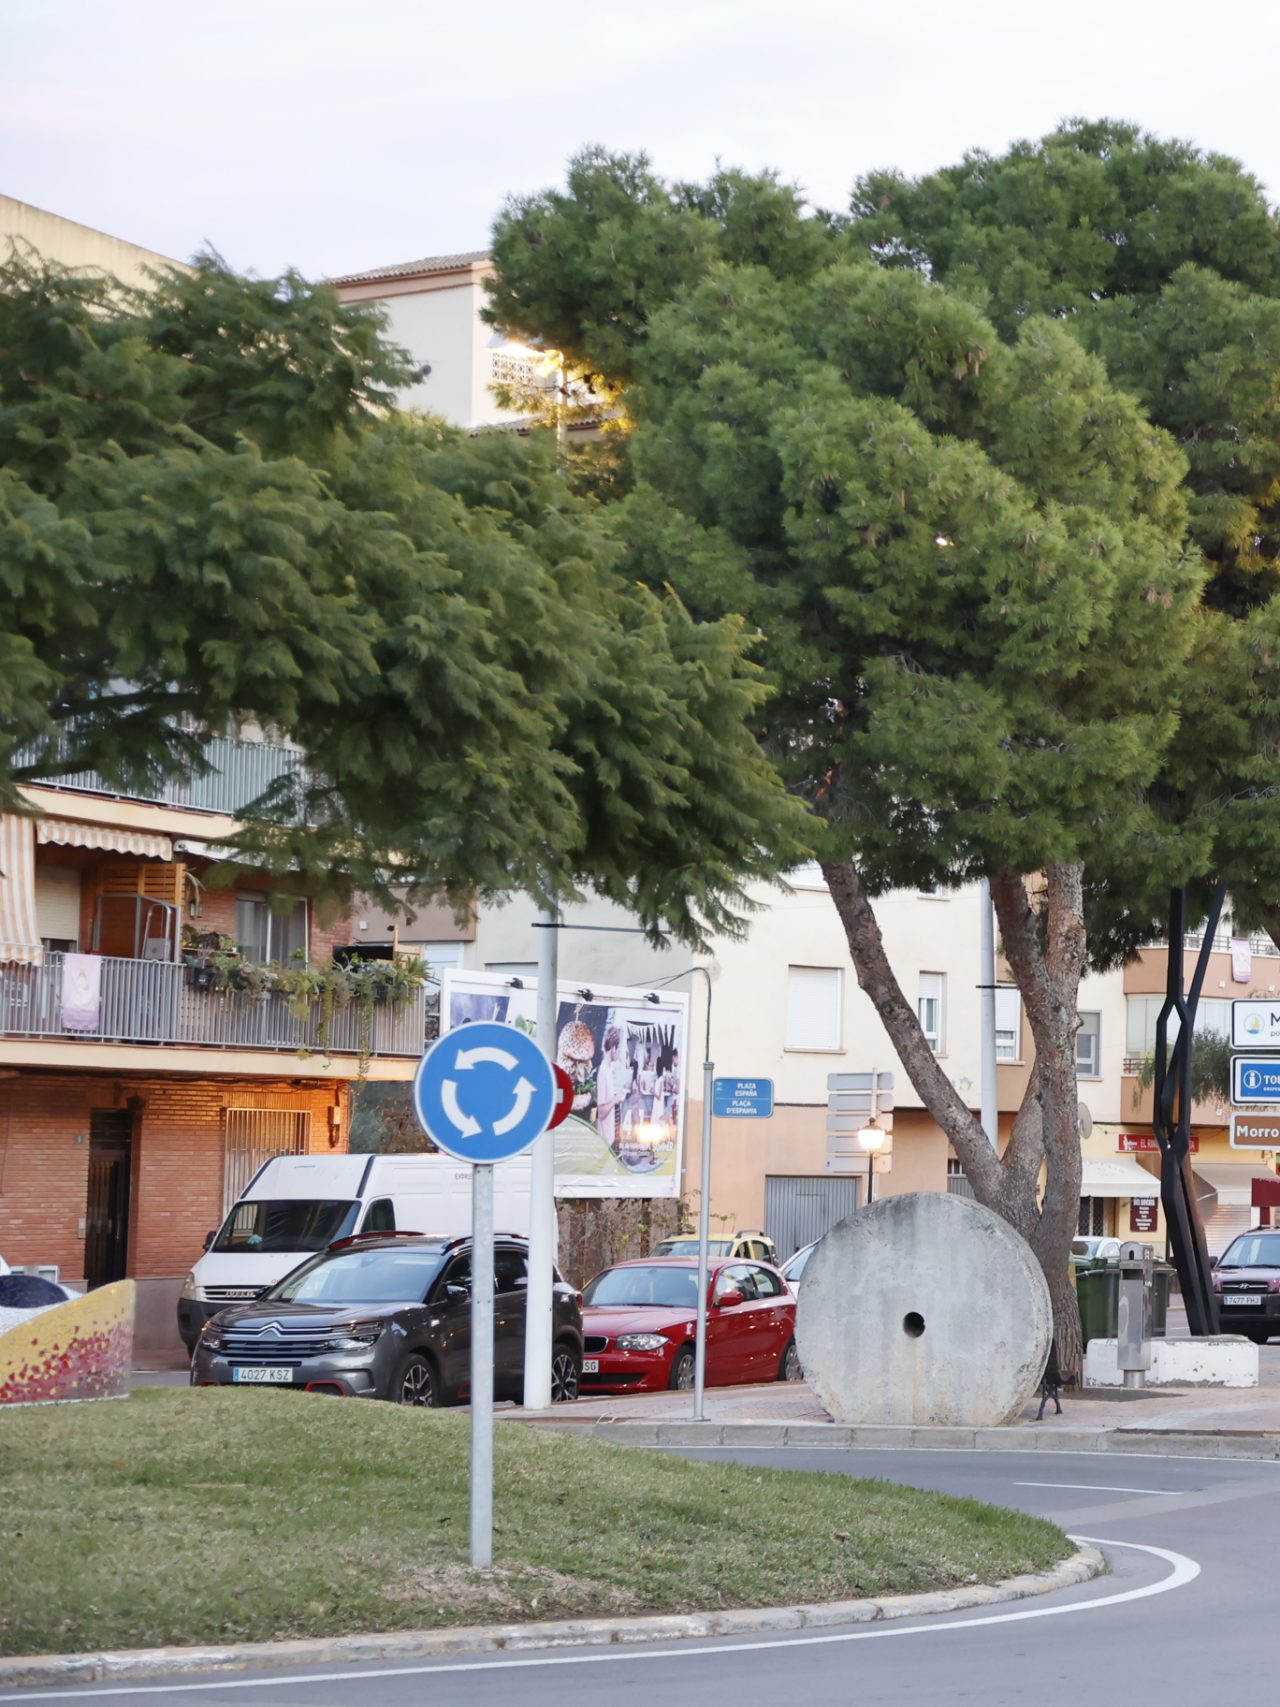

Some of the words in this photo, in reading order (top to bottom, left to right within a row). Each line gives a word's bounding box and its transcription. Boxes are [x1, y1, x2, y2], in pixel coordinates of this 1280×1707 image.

[735, 1089, 758, 1097] ESPAÑA
[732, 1100, 752, 1108] PLAÇA
[1236, 1125, 1280, 1138] Morro
[1228, 1296, 1245, 1304] 7477
[240, 1369, 267, 1380] 4027
[269, 1369, 290, 1381] KSZ
